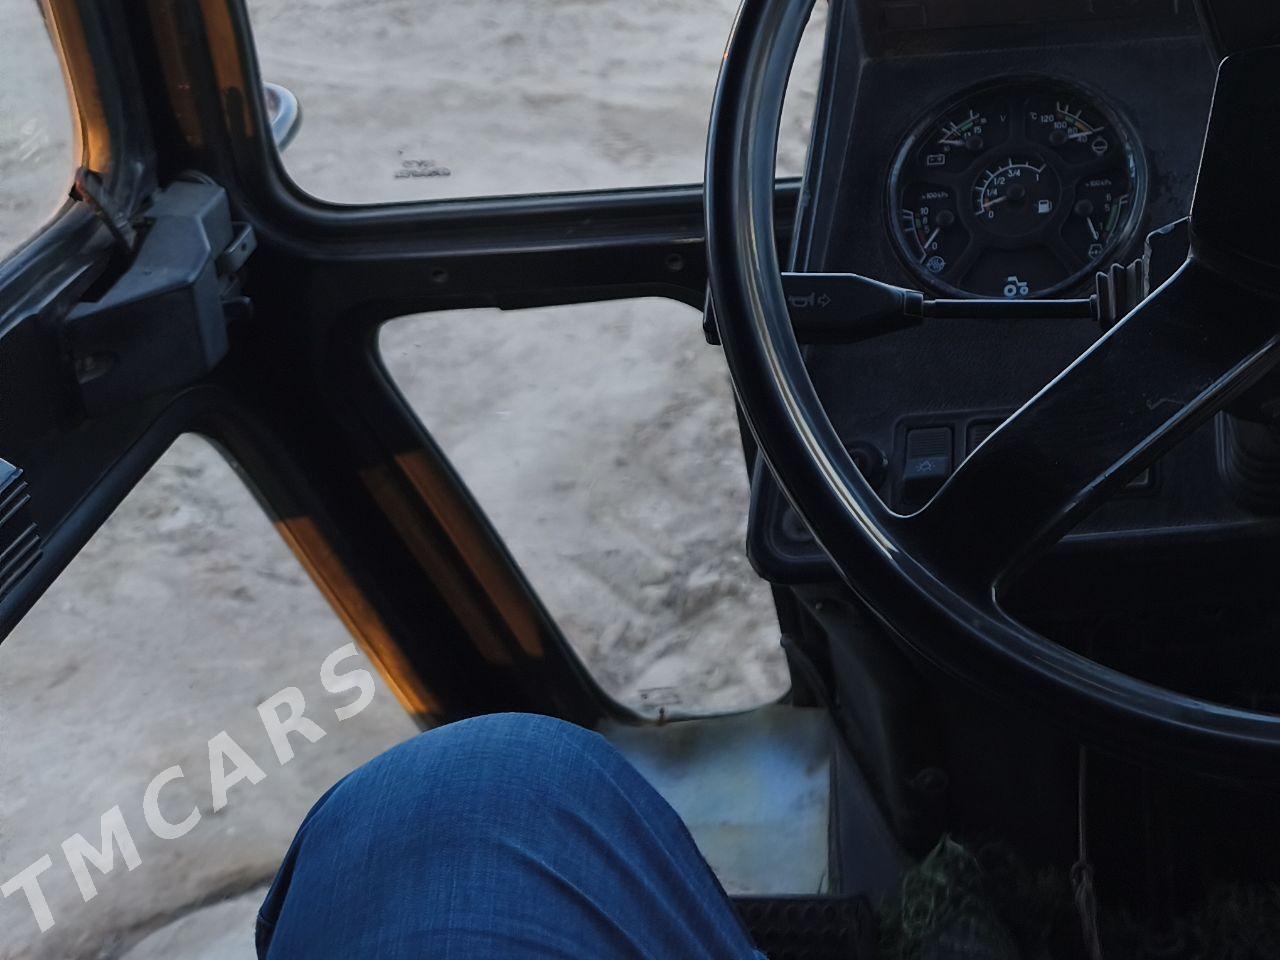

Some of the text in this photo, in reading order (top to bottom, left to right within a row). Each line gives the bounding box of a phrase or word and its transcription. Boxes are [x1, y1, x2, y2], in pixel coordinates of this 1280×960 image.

[1041, 115, 1055, 123] 120
[1007, 169, 1021, 178] 3/4
[994, 176, 1006, 186] 1/2
[920, 206, 930, 216] 10
[988, 210, 995, 219] 0
[932, 241, 939, 251] 0
